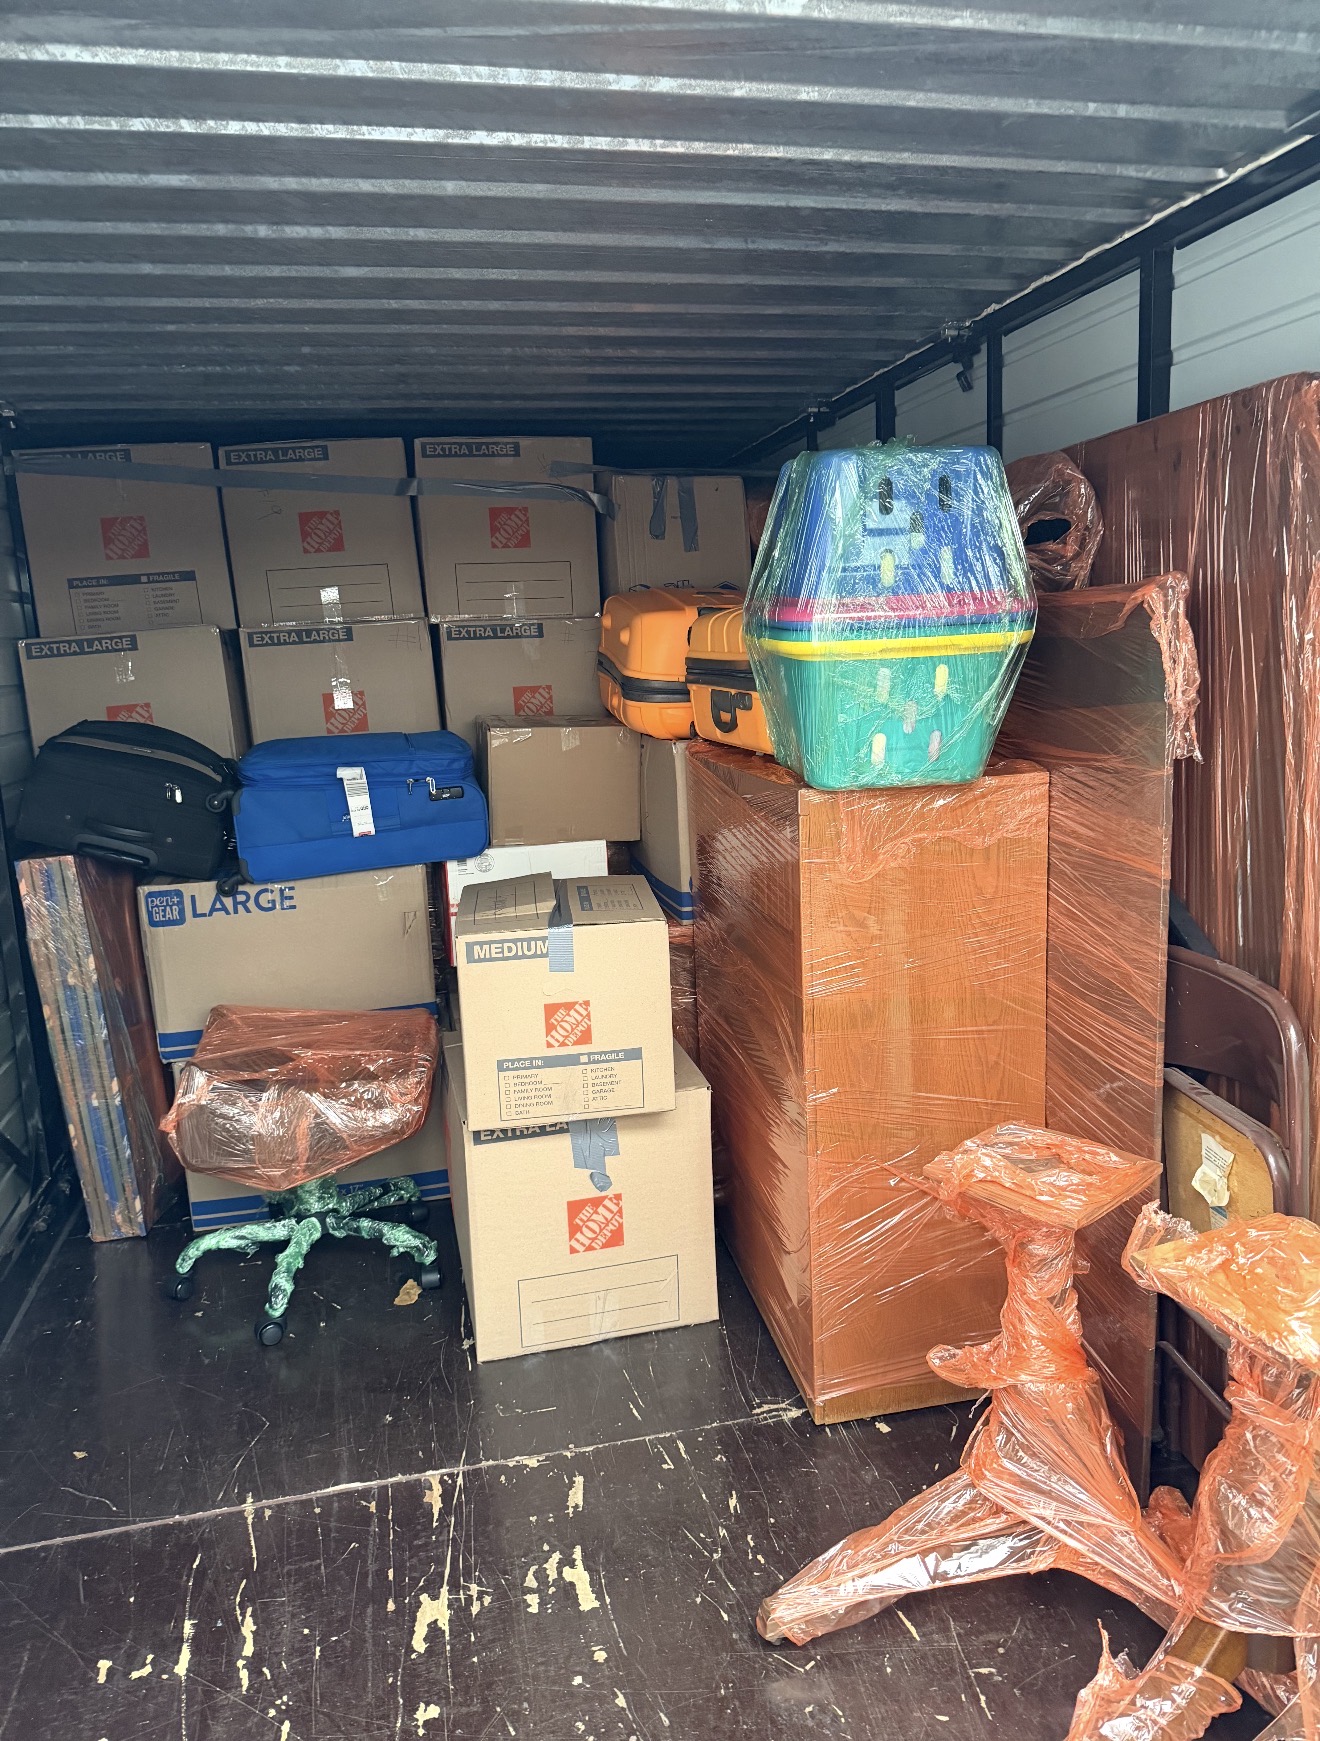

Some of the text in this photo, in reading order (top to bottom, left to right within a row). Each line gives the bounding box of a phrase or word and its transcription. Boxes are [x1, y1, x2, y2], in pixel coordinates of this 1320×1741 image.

[230, 447, 324, 463] EXTRA LARGE
[426, 442, 516, 456] EXTRA LARGE
[302, 510, 341, 552] HOME
[306, 516, 322, 532] THE
[492, 506, 529, 548] HOME
[494, 512, 510, 528] THE
[104, 516, 146, 560] HOME
[319, 526, 342, 552] DEPOT
[507, 522, 530, 548] DEPOT
[252, 628, 348, 646] EXTRA LARGE
[450, 624, 539, 638] EXTRA LARGE
[30, 637, 133, 656] EXTRA LARGE
[518, 690, 534, 706] THE
[519, 686, 552, 716] OME
[344, 706, 367, 734] DEPOT
[152, 905, 180, 922] GEAR
[190, 885, 298, 919] LARGE
[546, 1001, 590, 1048] HOME
[549, 1007, 568, 1026] THE
[564, 1016, 592, 1046] DEPOT
[504, 1060, 531, 1068] PLACE
[590, 1052, 625, 1062] FRAGILE
[592, 1080, 622, 1088] BASEMENT
[569, 1194, 624, 1252] HOME
[573, 1203, 596, 1227] THE
[591, 1212, 624, 1250] DEPOT
